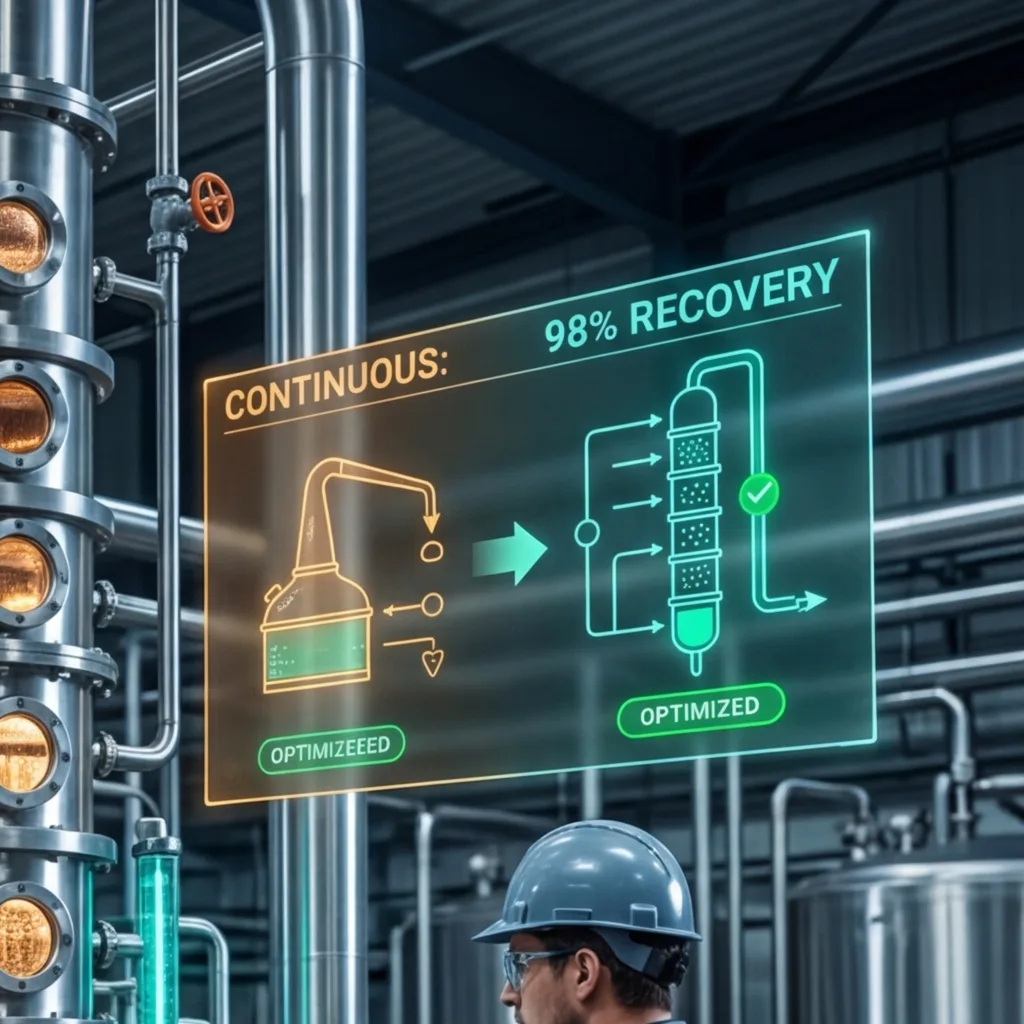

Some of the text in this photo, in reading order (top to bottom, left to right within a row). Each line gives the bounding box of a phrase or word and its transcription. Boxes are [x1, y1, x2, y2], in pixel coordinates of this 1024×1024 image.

[544, 257, 840, 353] 98% RECOVERY
[224, 346, 448, 421] CONTINUOUS:
[639, 694, 760, 727] OPTIMIZED
[270, 735, 391, 765] OPTIMIZEEED
